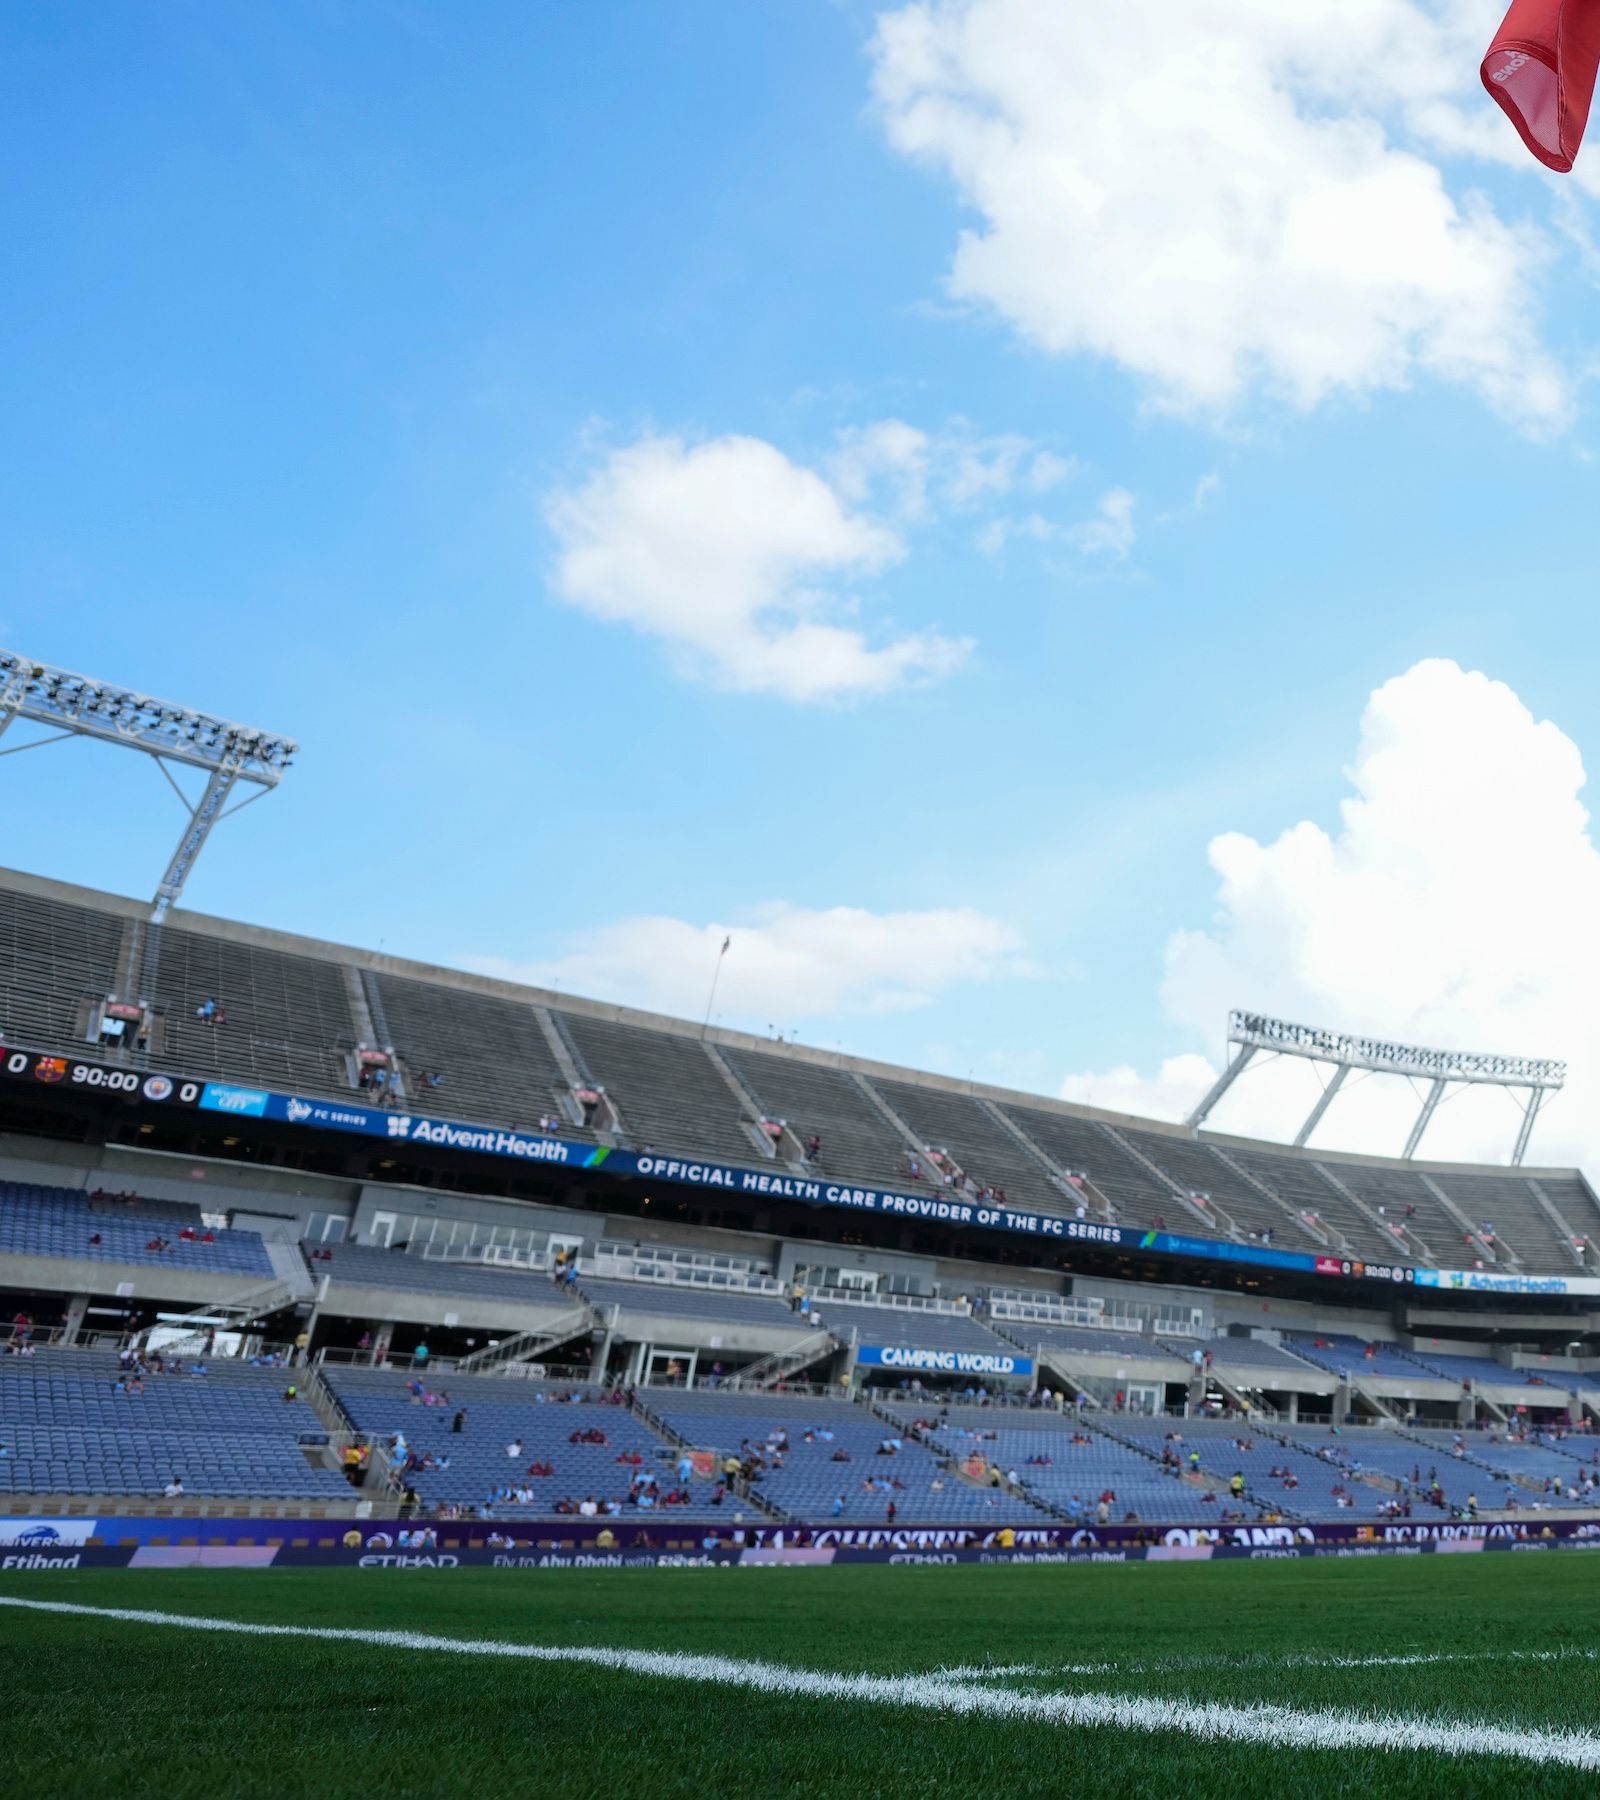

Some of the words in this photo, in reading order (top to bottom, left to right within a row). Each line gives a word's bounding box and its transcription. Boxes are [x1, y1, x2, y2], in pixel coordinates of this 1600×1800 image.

[8, 1054, 28, 1073] 0
[72, 1065, 139, 1092] 90:00
[180, 1083, 198, 1102] 0
[412, 1120, 569, 1162] AdventHealth
[637, 1157, 735, 1187] OFFICIAL
[743, 1174, 819, 1199] HEALTH
[826, 1186, 876, 1208] CARE
[881, 1194, 972, 1222] PROVIDER
[977, 1209, 1000, 1226] OF
[1006, 1213, 1037, 1231] THE
[1042, 1219, 1063, 1235] FC
[1068, 1223, 1122, 1243] SERIES
[880, 1348, 955, 1370] CAMPING
[957, 1354, 1015, 1374] WORLD
[359, 1555, 459, 1568] ETIHAD
[889, 1553, 957, 1566] ETIHAD
